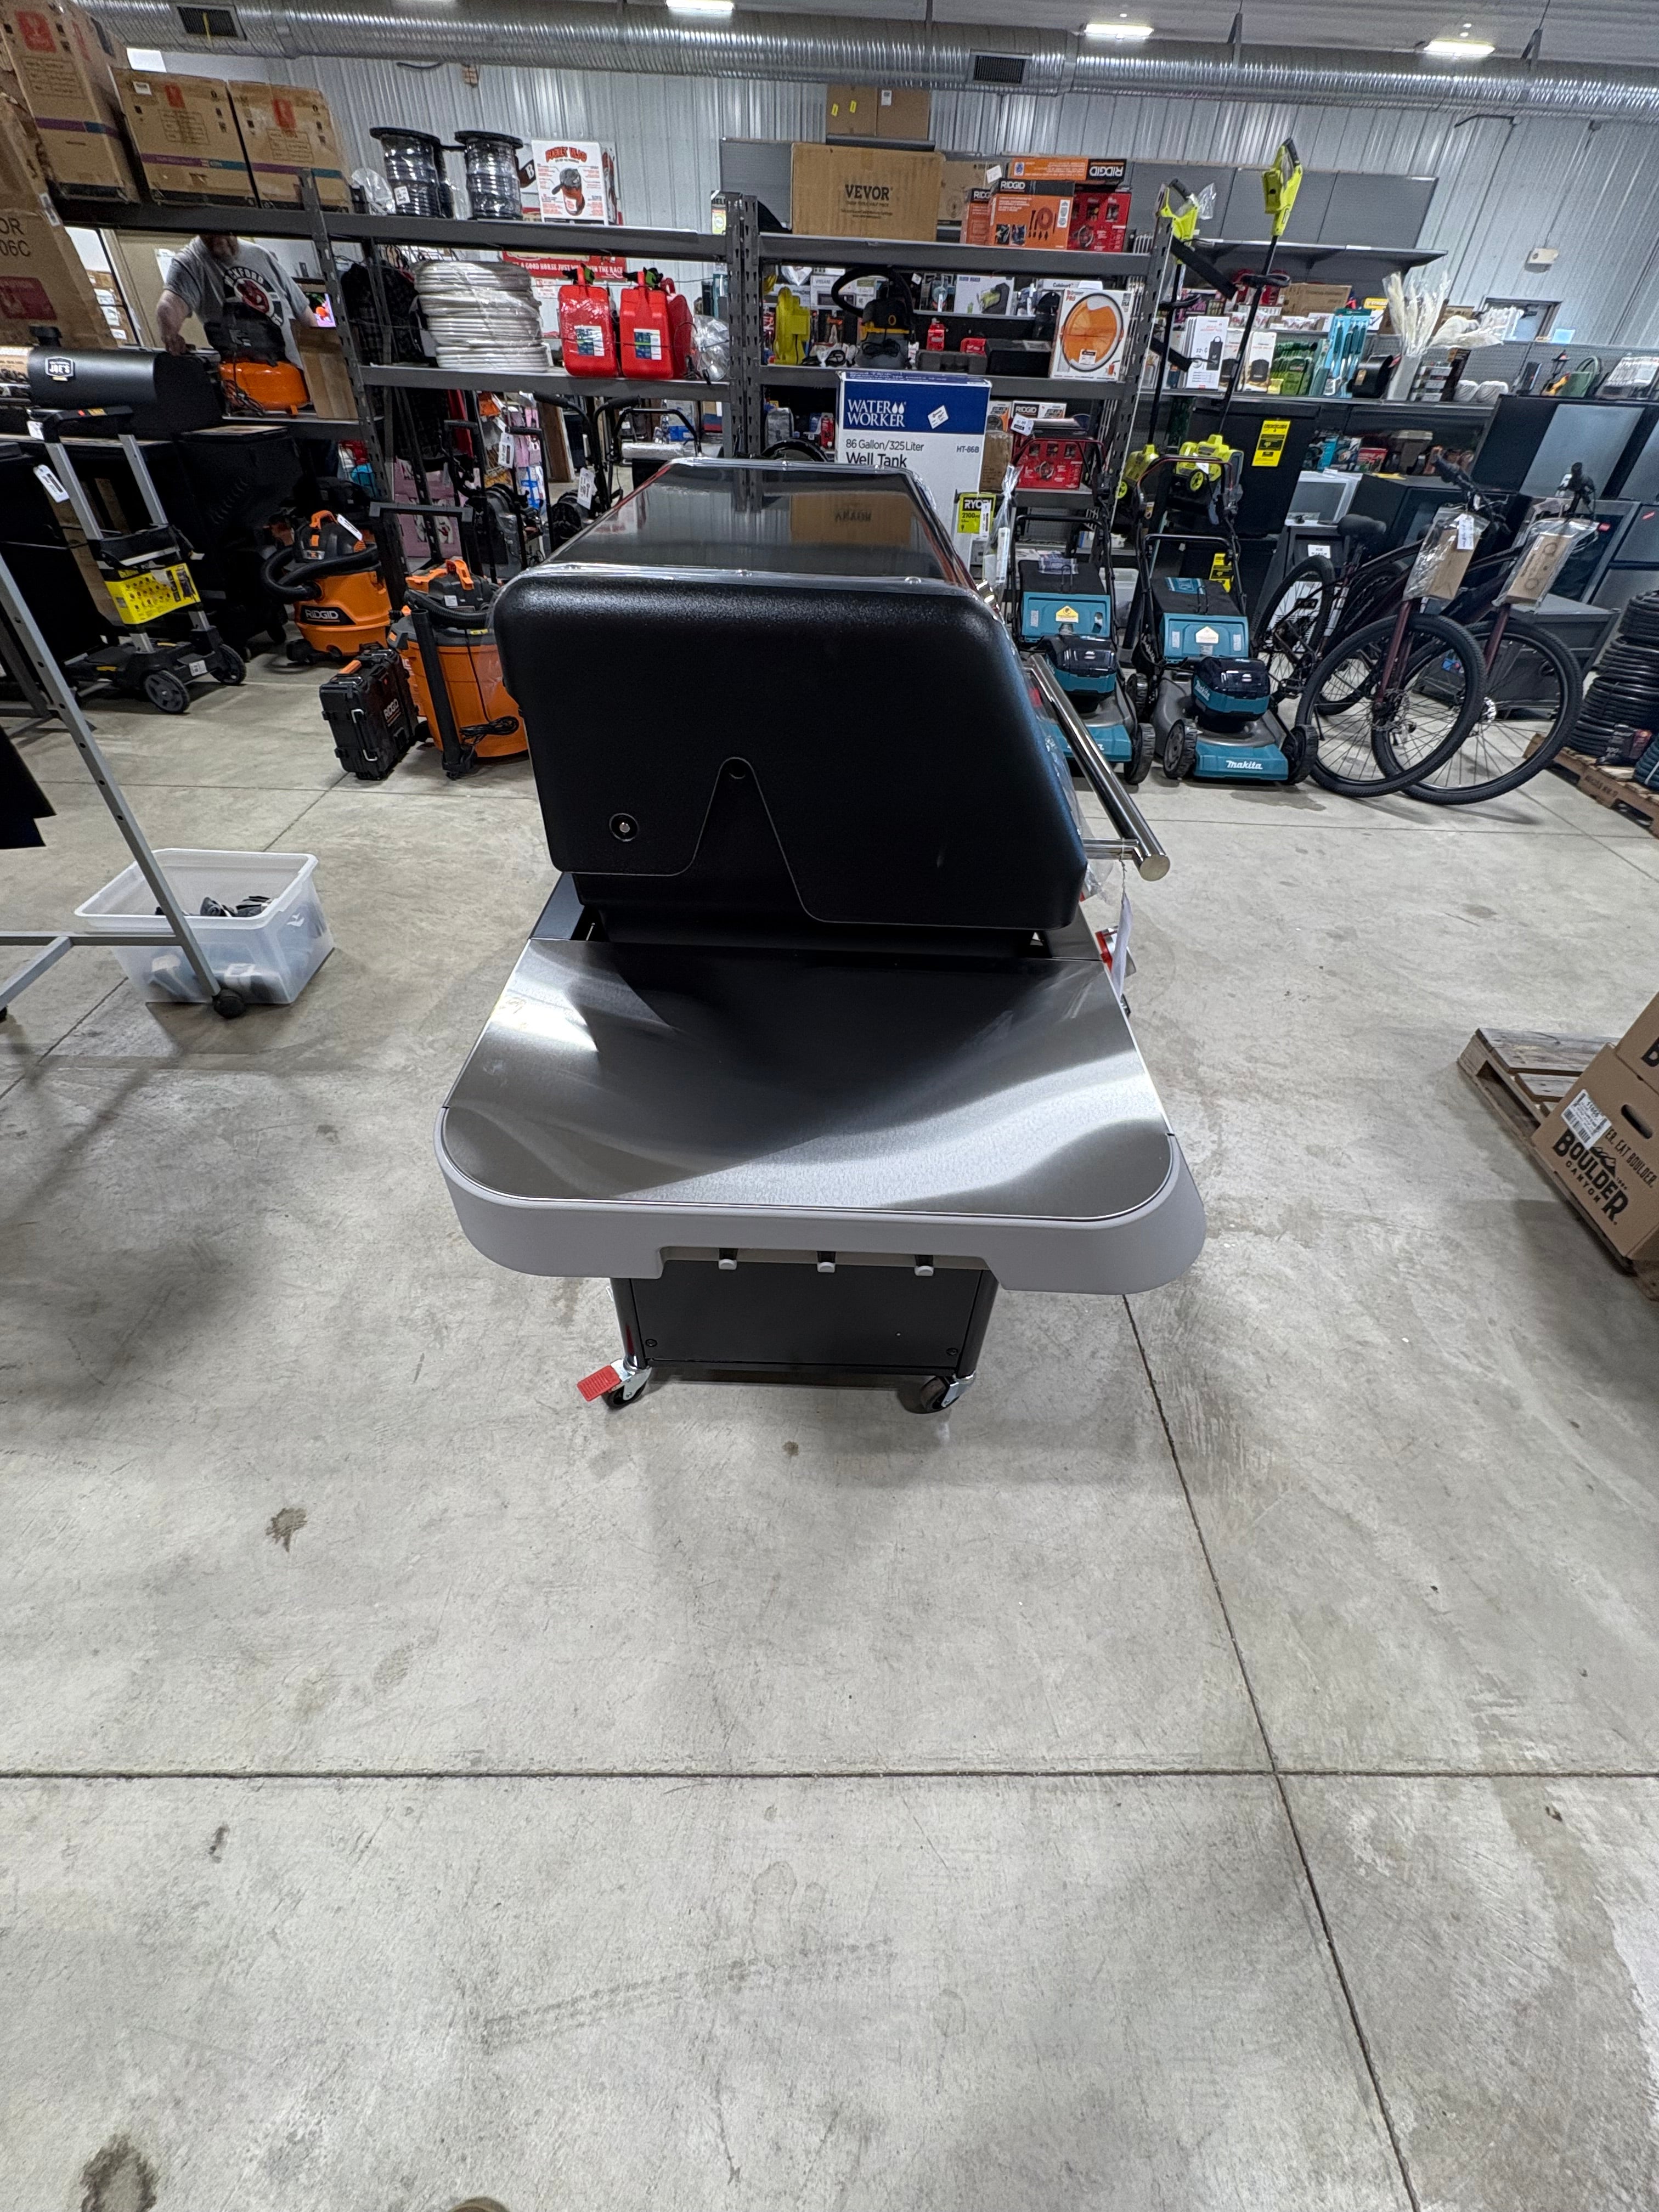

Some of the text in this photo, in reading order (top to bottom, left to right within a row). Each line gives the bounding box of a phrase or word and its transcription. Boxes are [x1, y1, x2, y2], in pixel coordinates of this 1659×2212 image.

[1090, 166, 1124, 177] RIDGID
[845, 184, 889, 200] VEVOR
[1000, 180, 1025, 190] RIDGID
[973, 191, 991, 199] RIDG
[848, 399, 891, 414] WATER
[847, 412, 905, 427] WORKER
[846, 439, 856, 448] 86
[846, 452, 907, 467] Well Tank
[305, 608, 339, 619] RIDGID
[1615, 1139, 1631, 1158] EAT
[1552, 1128, 1628, 1222] BOULDER
[1566, 1160, 1601, 1204] CANYON
